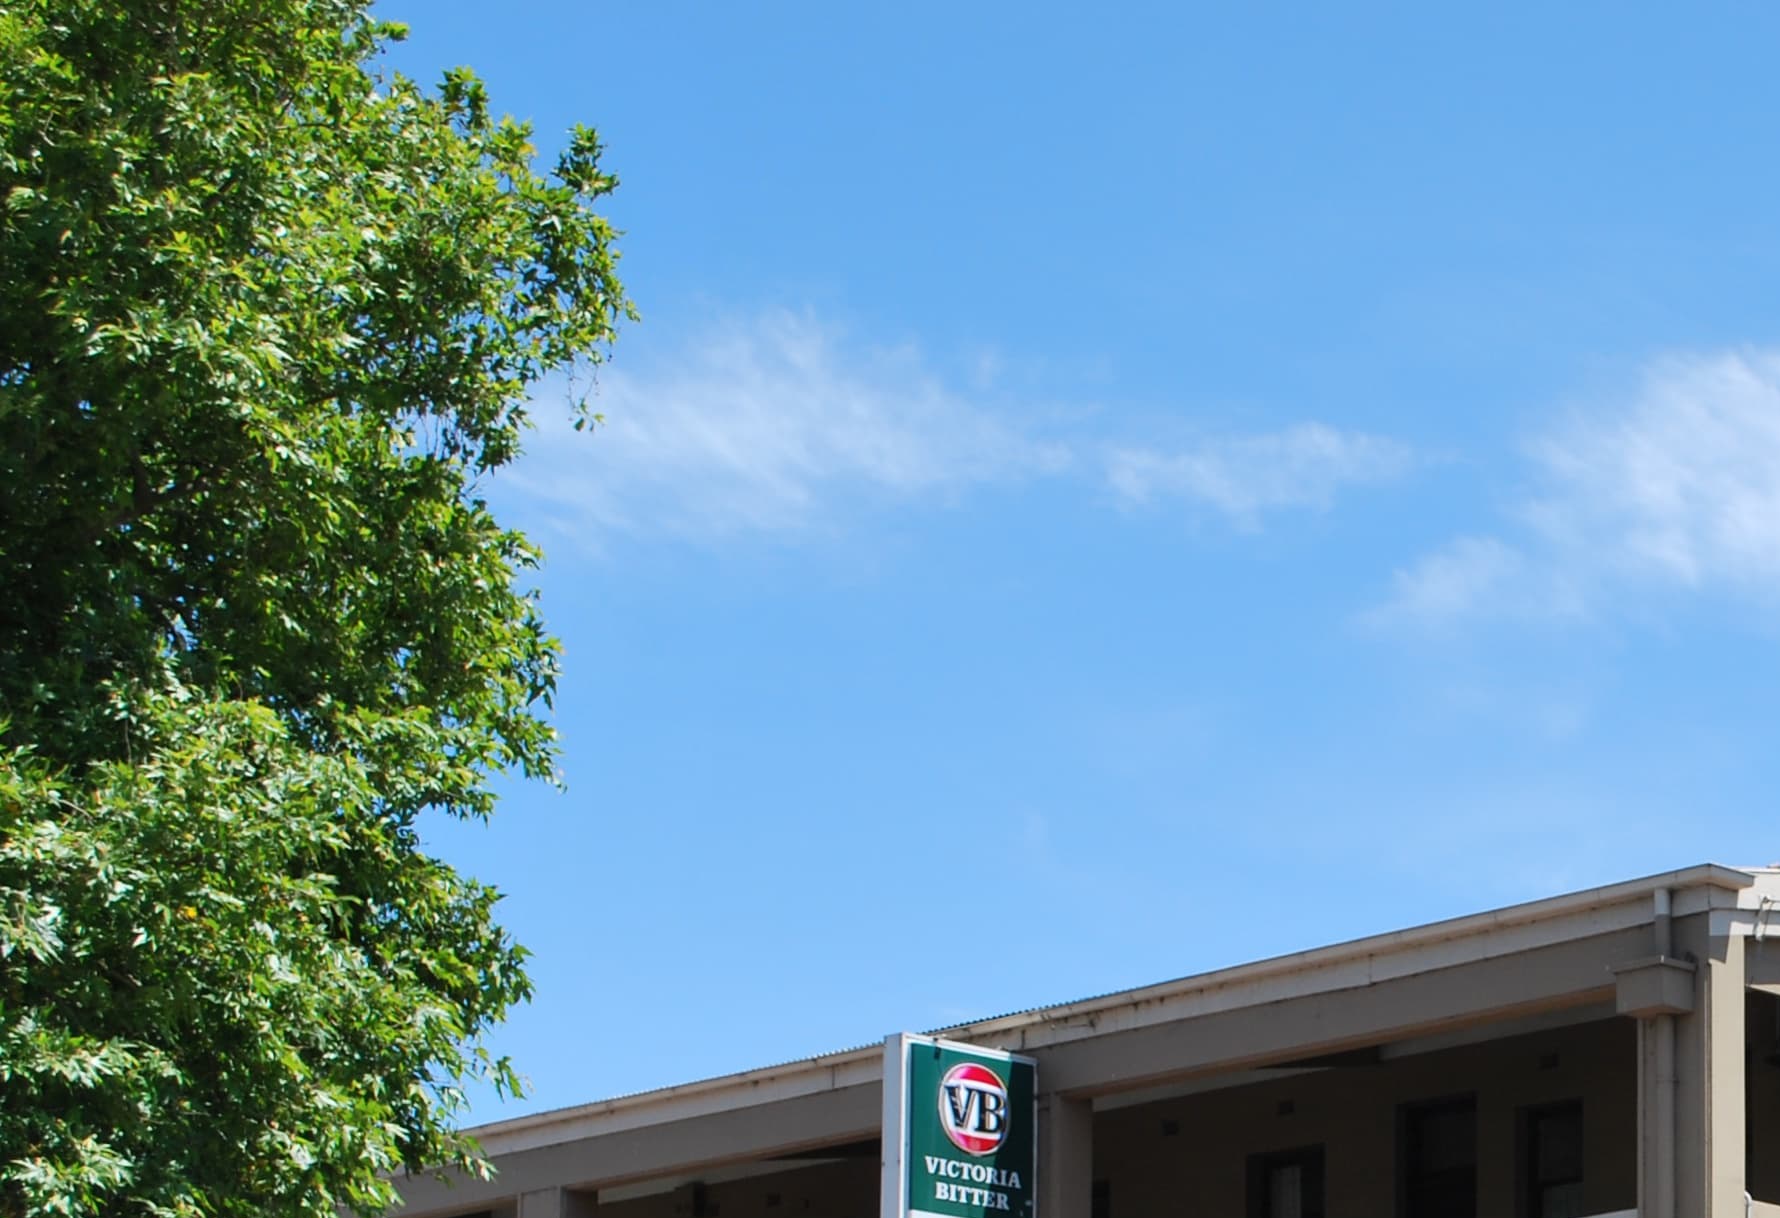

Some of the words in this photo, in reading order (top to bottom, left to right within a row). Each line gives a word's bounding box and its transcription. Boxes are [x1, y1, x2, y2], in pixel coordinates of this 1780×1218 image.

[943, 1085, 1008, 1132] VB
[924, 1155, 1022, 1189] VICTORIA
[935, 1181, 1010, 1210] BITTER
